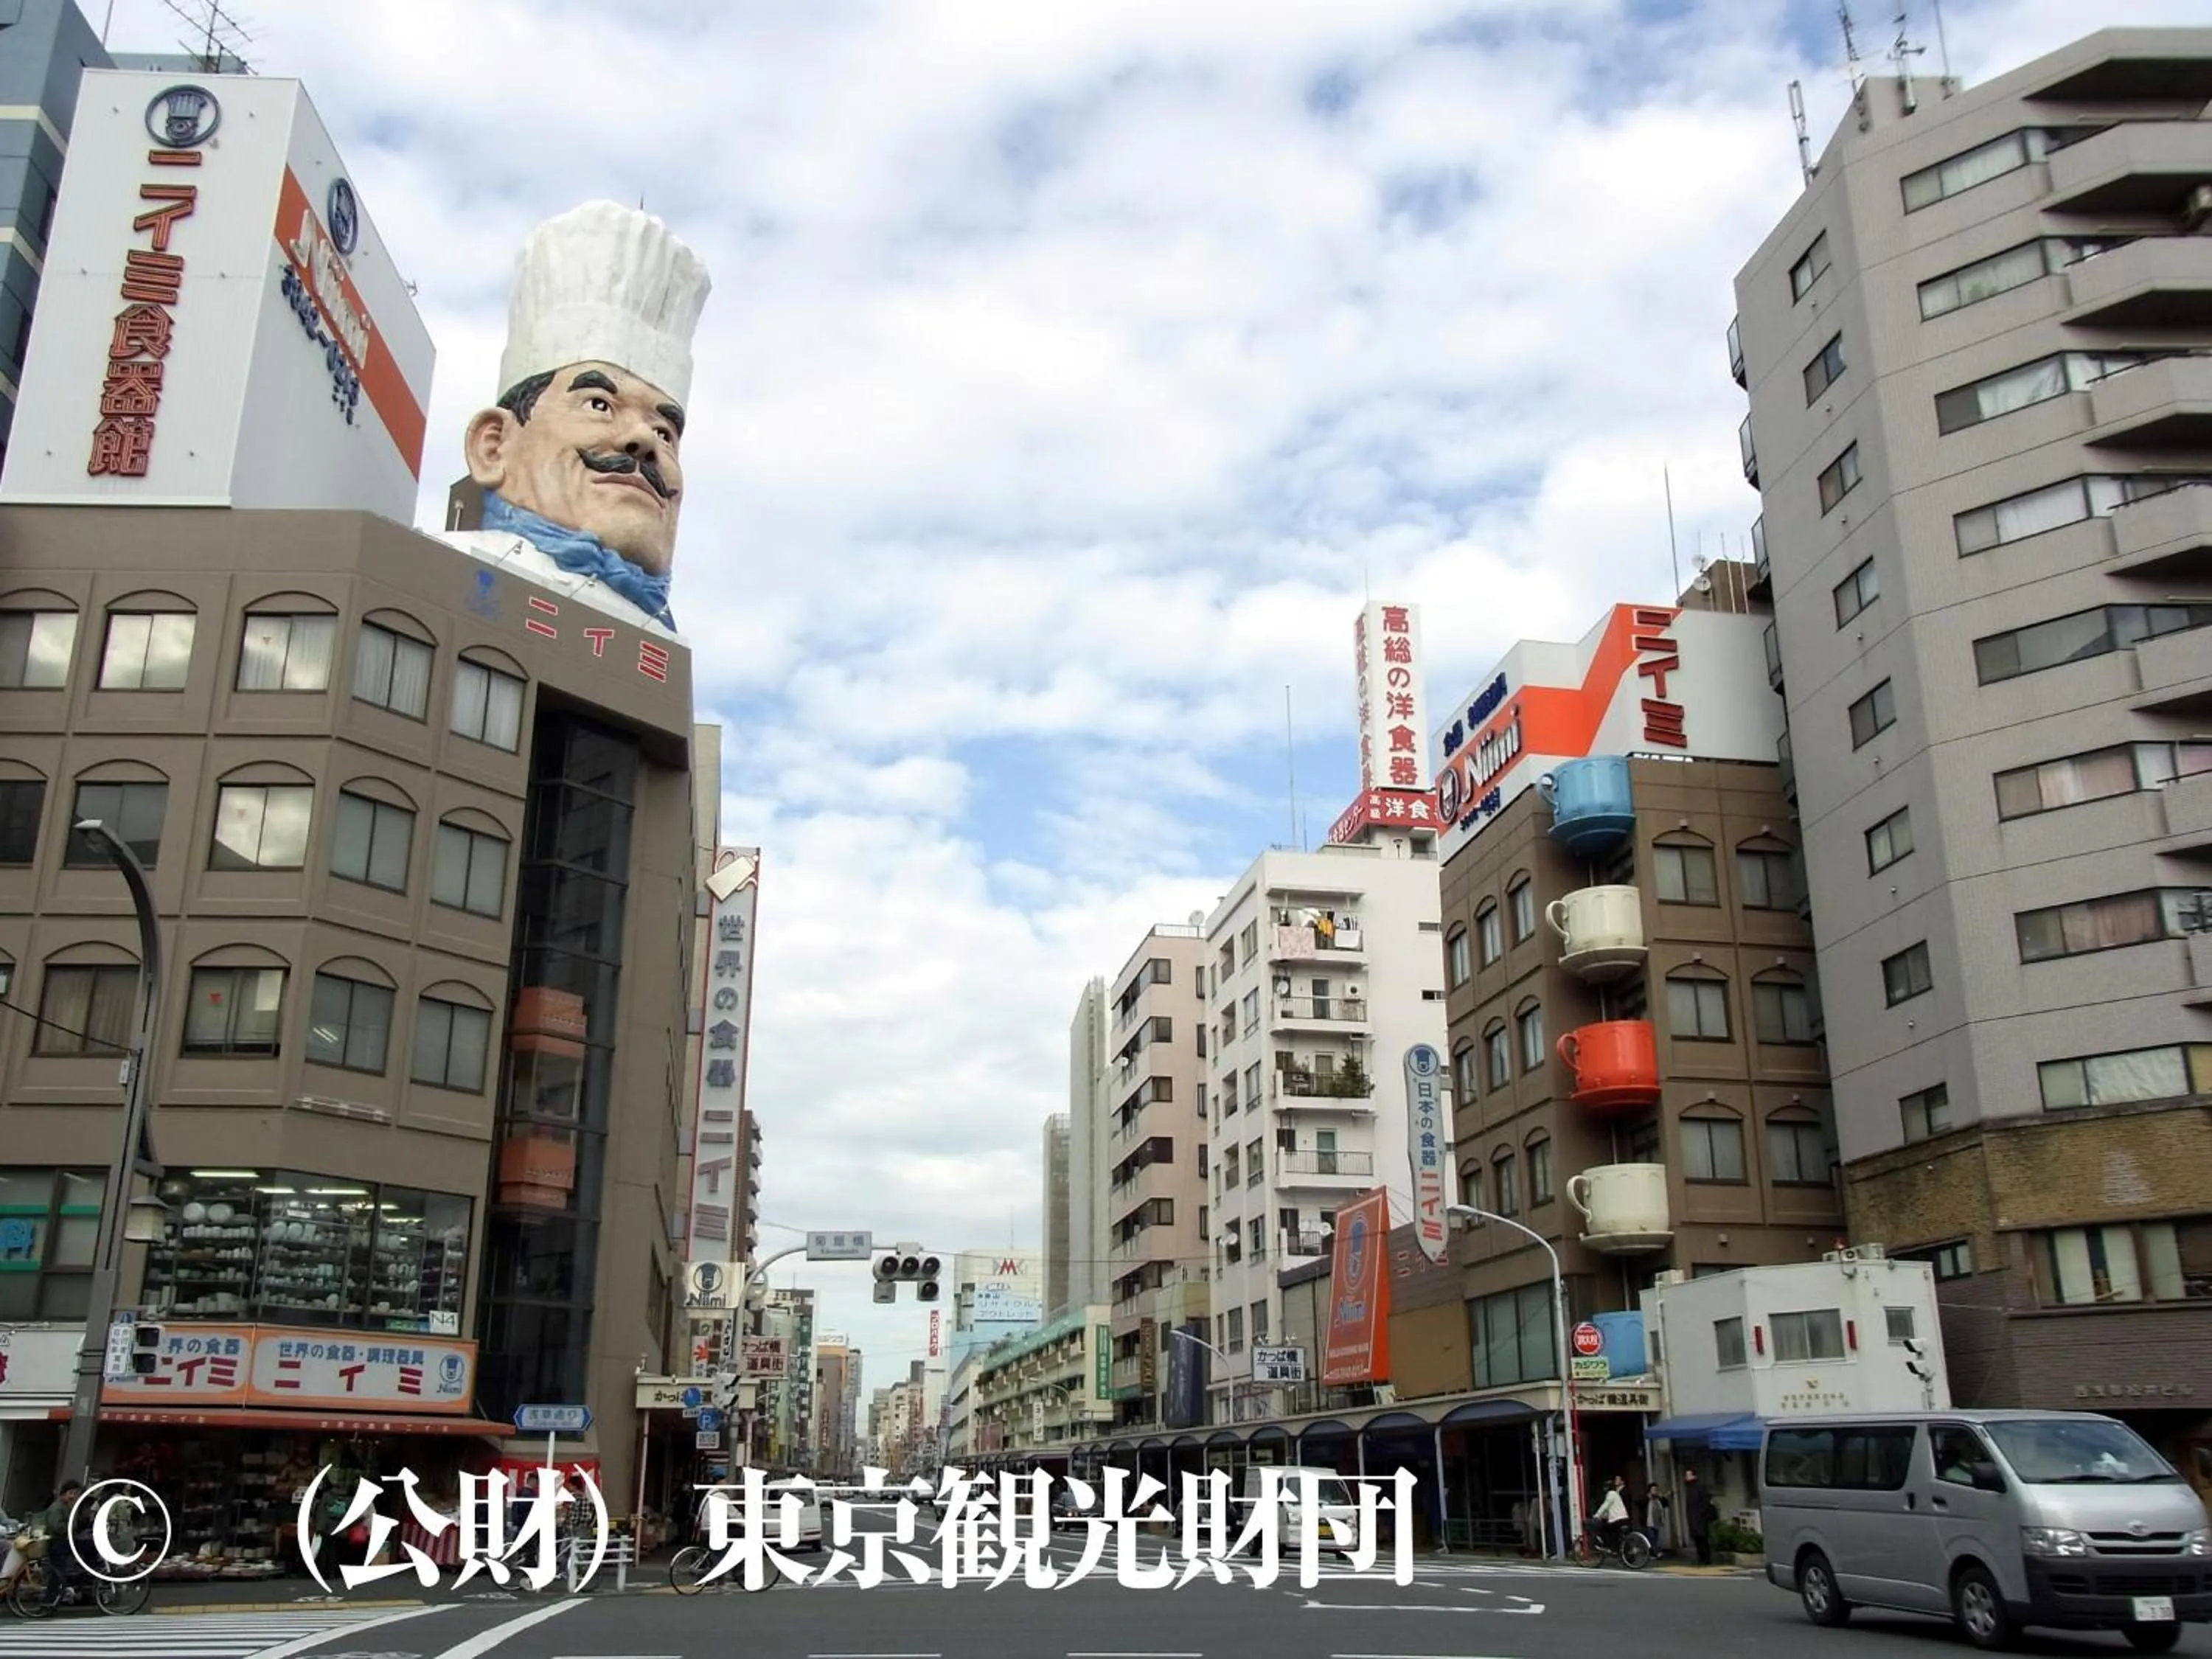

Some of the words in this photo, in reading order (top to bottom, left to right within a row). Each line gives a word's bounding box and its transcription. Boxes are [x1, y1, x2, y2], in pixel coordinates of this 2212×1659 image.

[87, 149, 203, 476] ニイミ食器館
[525, 596, 669, 683] ニイミ
[1635, 609, 1687, 748] ニイミ
[1382, 605, 1419, 786] 高総の洋食器
[1462, 704, 1521, 804] Niimi
[1385, 797, 1439, 821] 洋食
[706, 914, 745, 1088] 世界の食器
[1417, 1081, 1437, 1166] 日本の食器
[694, 1109, 734, 1242] ニイミ
[1420, 1172, 1443, 1241] ニイミ
[686, 1292, 726, 1307] Niimi
[274, 1360, 423, 1395] ニイミ
[1257, 1349, 1298, 1363] かっぱ橋
[1267, 1365, 1301, 1379] 道具街
[1574, 1360, 1607, 1369] カジワラ
